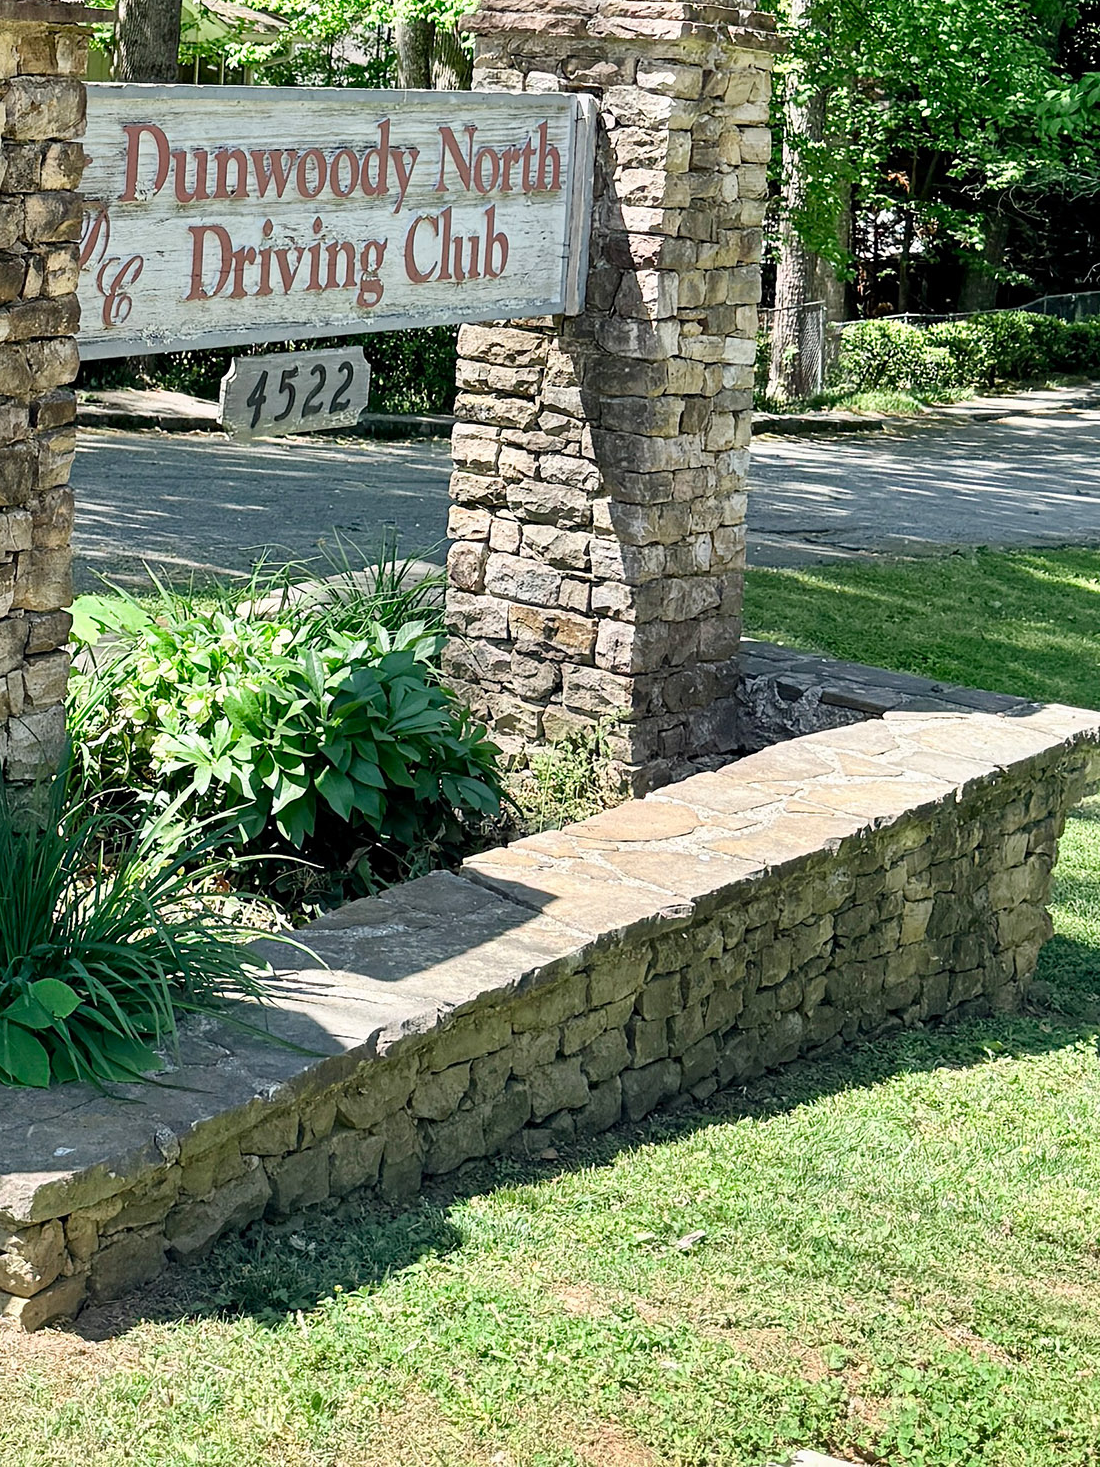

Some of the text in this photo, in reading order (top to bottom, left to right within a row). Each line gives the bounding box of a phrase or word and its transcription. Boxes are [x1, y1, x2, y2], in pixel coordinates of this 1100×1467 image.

[120, 117, 561, 214] Dunwoody North
[186, 216, 389, 308] Driving
[404, 204, 510, 285] Club
[246, 360, 355, 429] 4522
